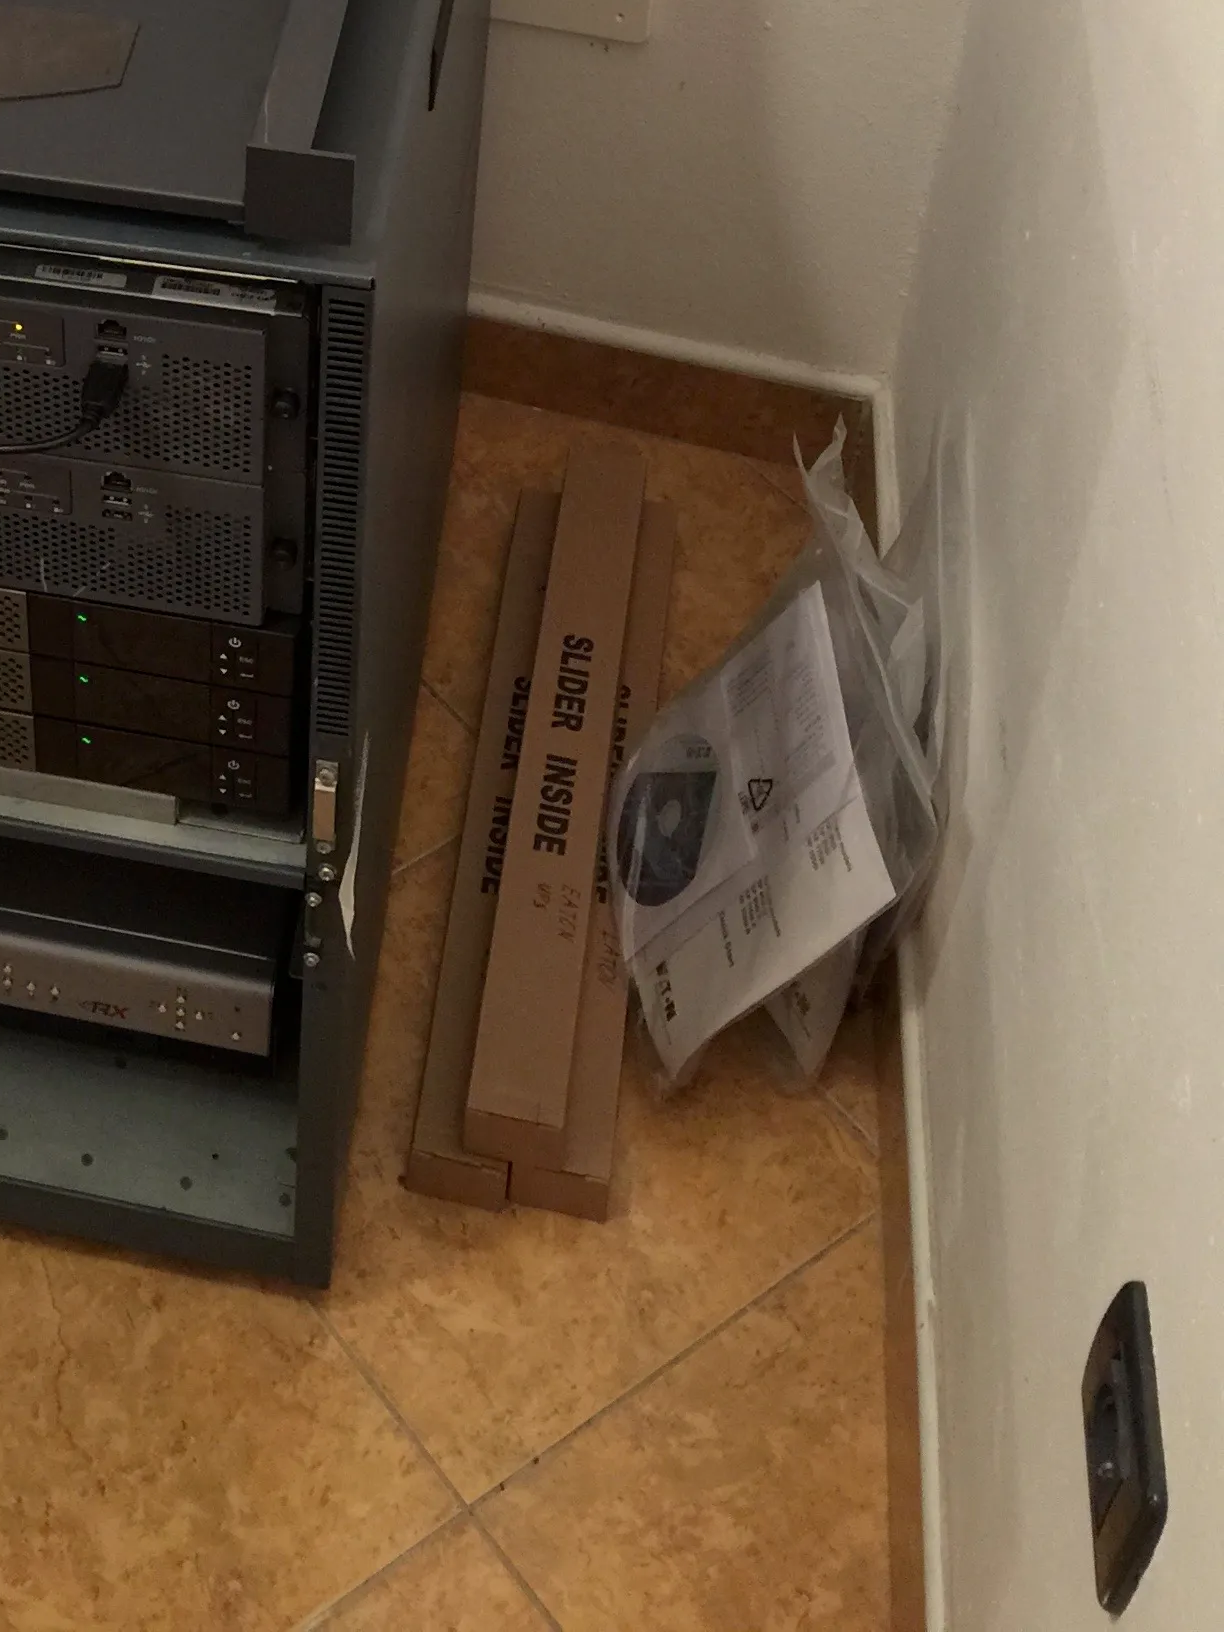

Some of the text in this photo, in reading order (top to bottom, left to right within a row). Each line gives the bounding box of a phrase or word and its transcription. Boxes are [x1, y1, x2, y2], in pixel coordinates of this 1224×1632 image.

[481, 675, 533, 896] SLIDER INSIDE
[532, 632, 595, 857] SLIDER INSIDE
[723, 941, 735, 969] Start
